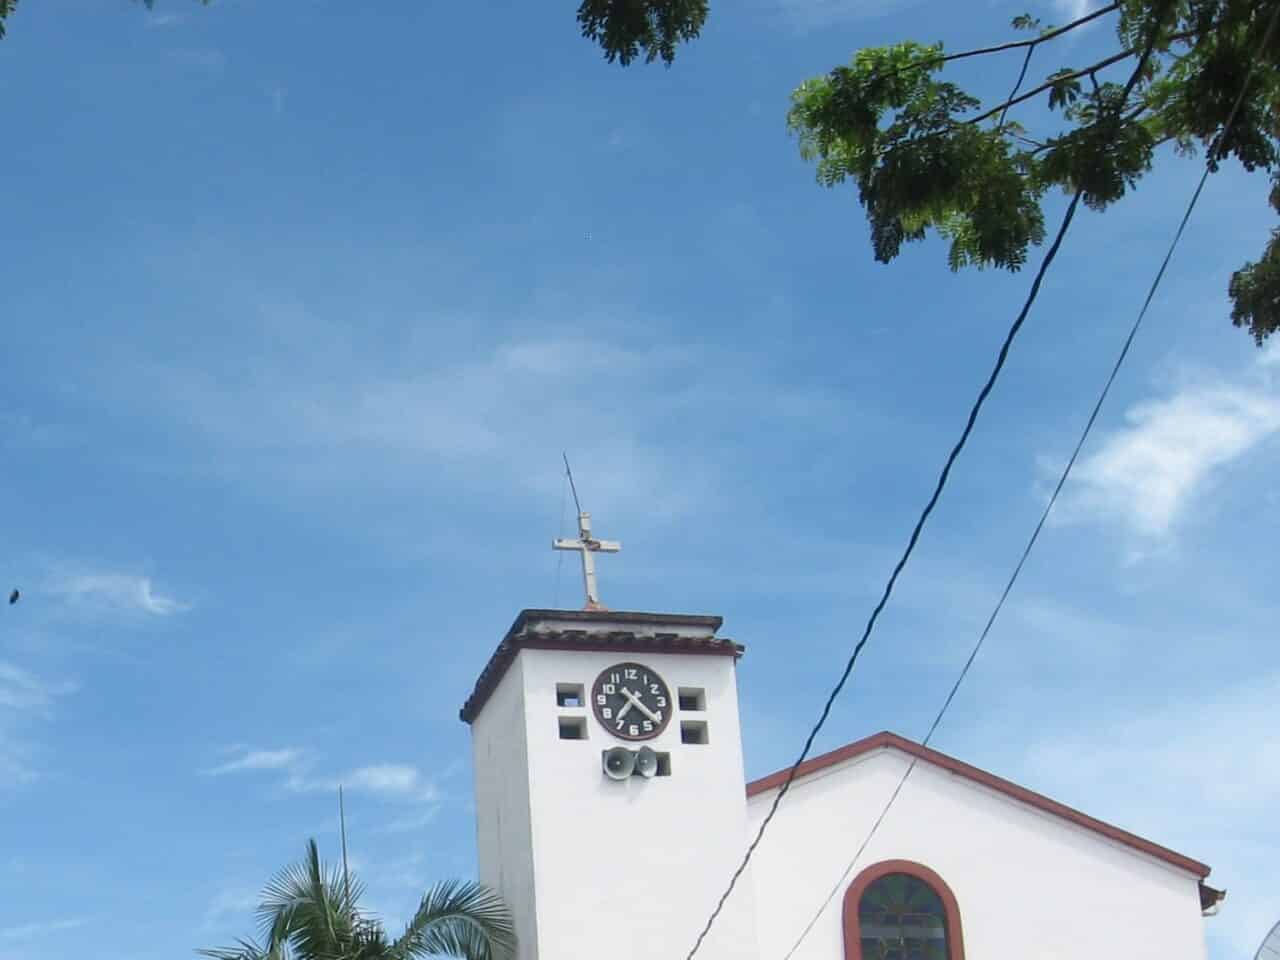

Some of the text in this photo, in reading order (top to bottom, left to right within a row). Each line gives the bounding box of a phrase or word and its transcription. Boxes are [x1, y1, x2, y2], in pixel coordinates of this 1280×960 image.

[610, 673, 620, 684] 11
[624, 669, 638, 680] 12
[643, 674, 648, 685] 1
[602, 684, 616, 695] 10
[650, 684, 660, 695] 2
[597, 695, 607, 705] 9
[656, 697, 667, 708] 3
[615, 719, 625, 730] 7
[642, 720, 653, 731] 5
[629, 725, 639, 736] 6
